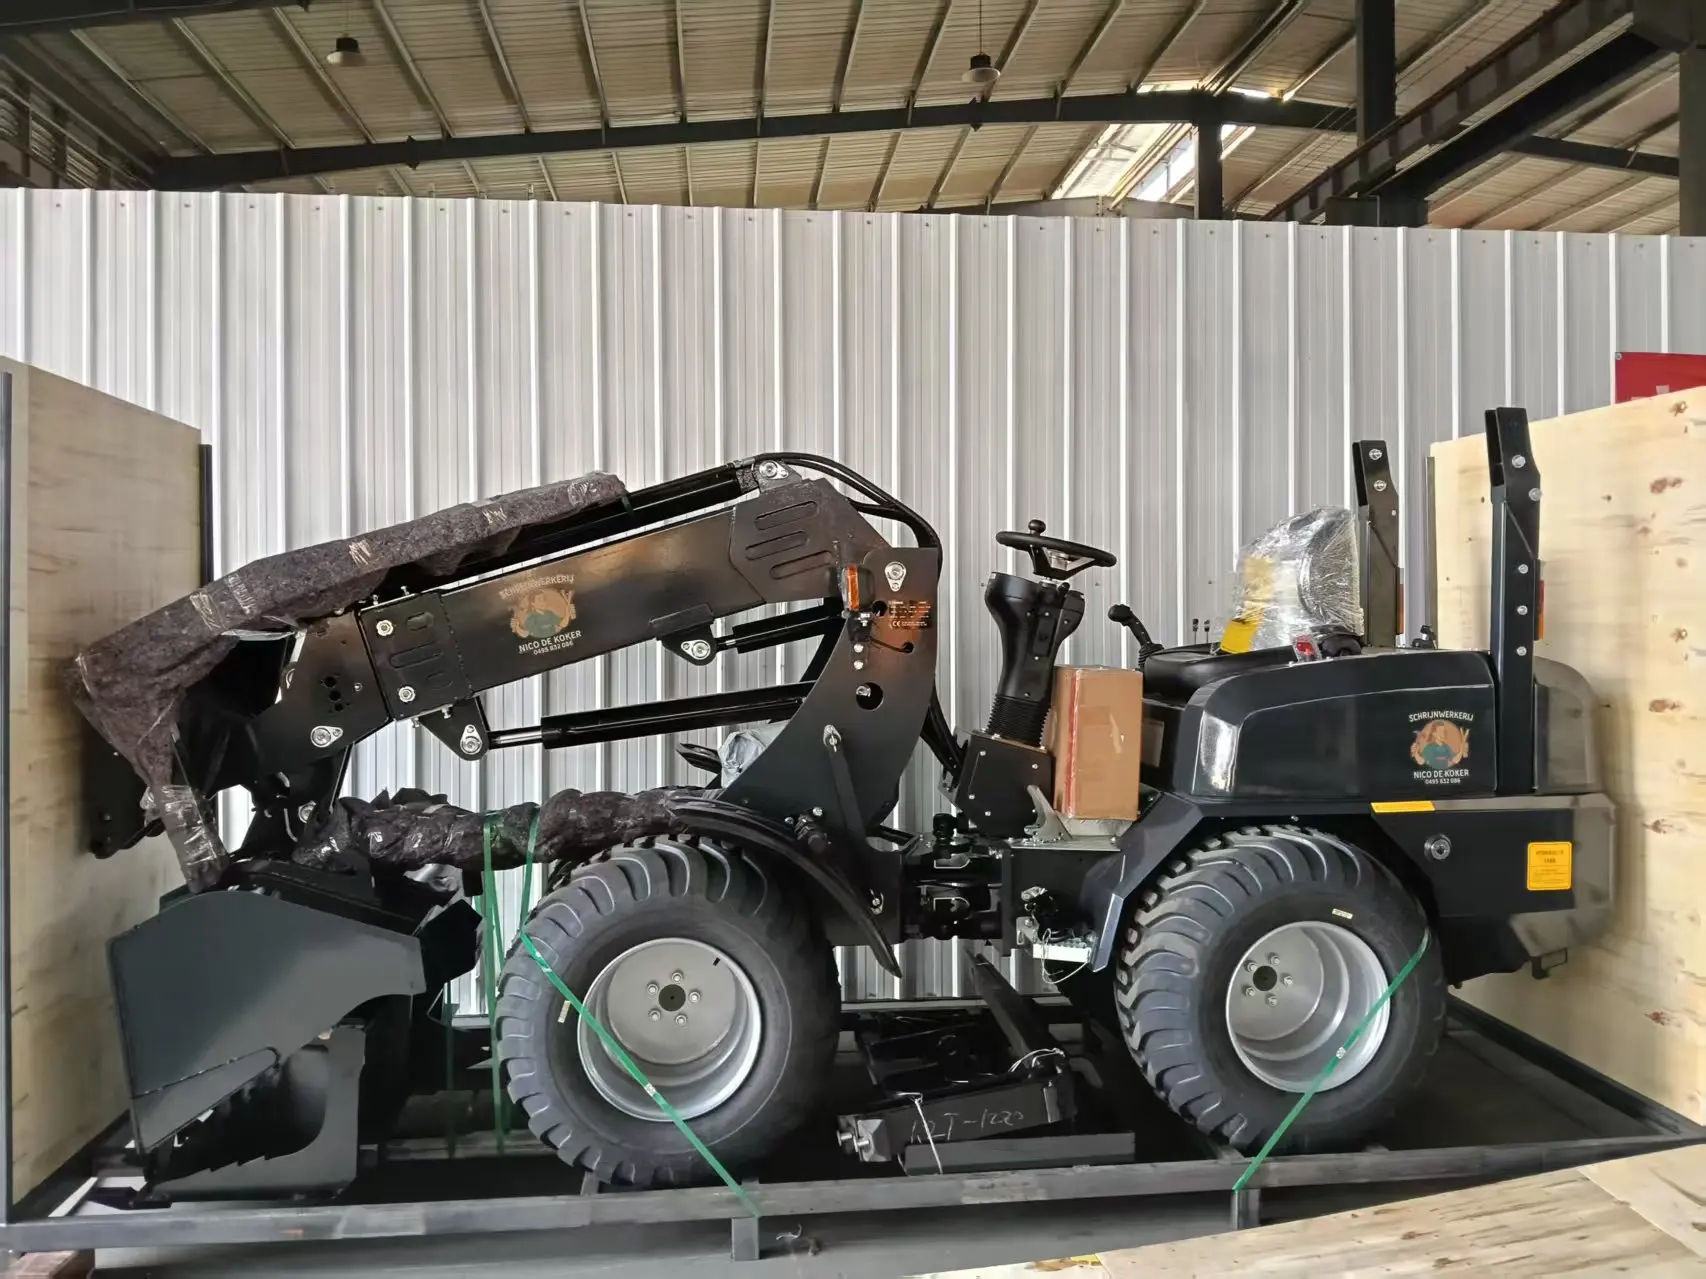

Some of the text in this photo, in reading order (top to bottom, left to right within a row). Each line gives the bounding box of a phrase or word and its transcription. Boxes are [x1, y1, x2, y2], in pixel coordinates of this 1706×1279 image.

[518, 630, 581, 654] NICO DE KOKER
[1408, 710, 1474, 723] SCHRIJNWERKERIJ
[1413, 769, 1469, 779] NICO DE KOKER
